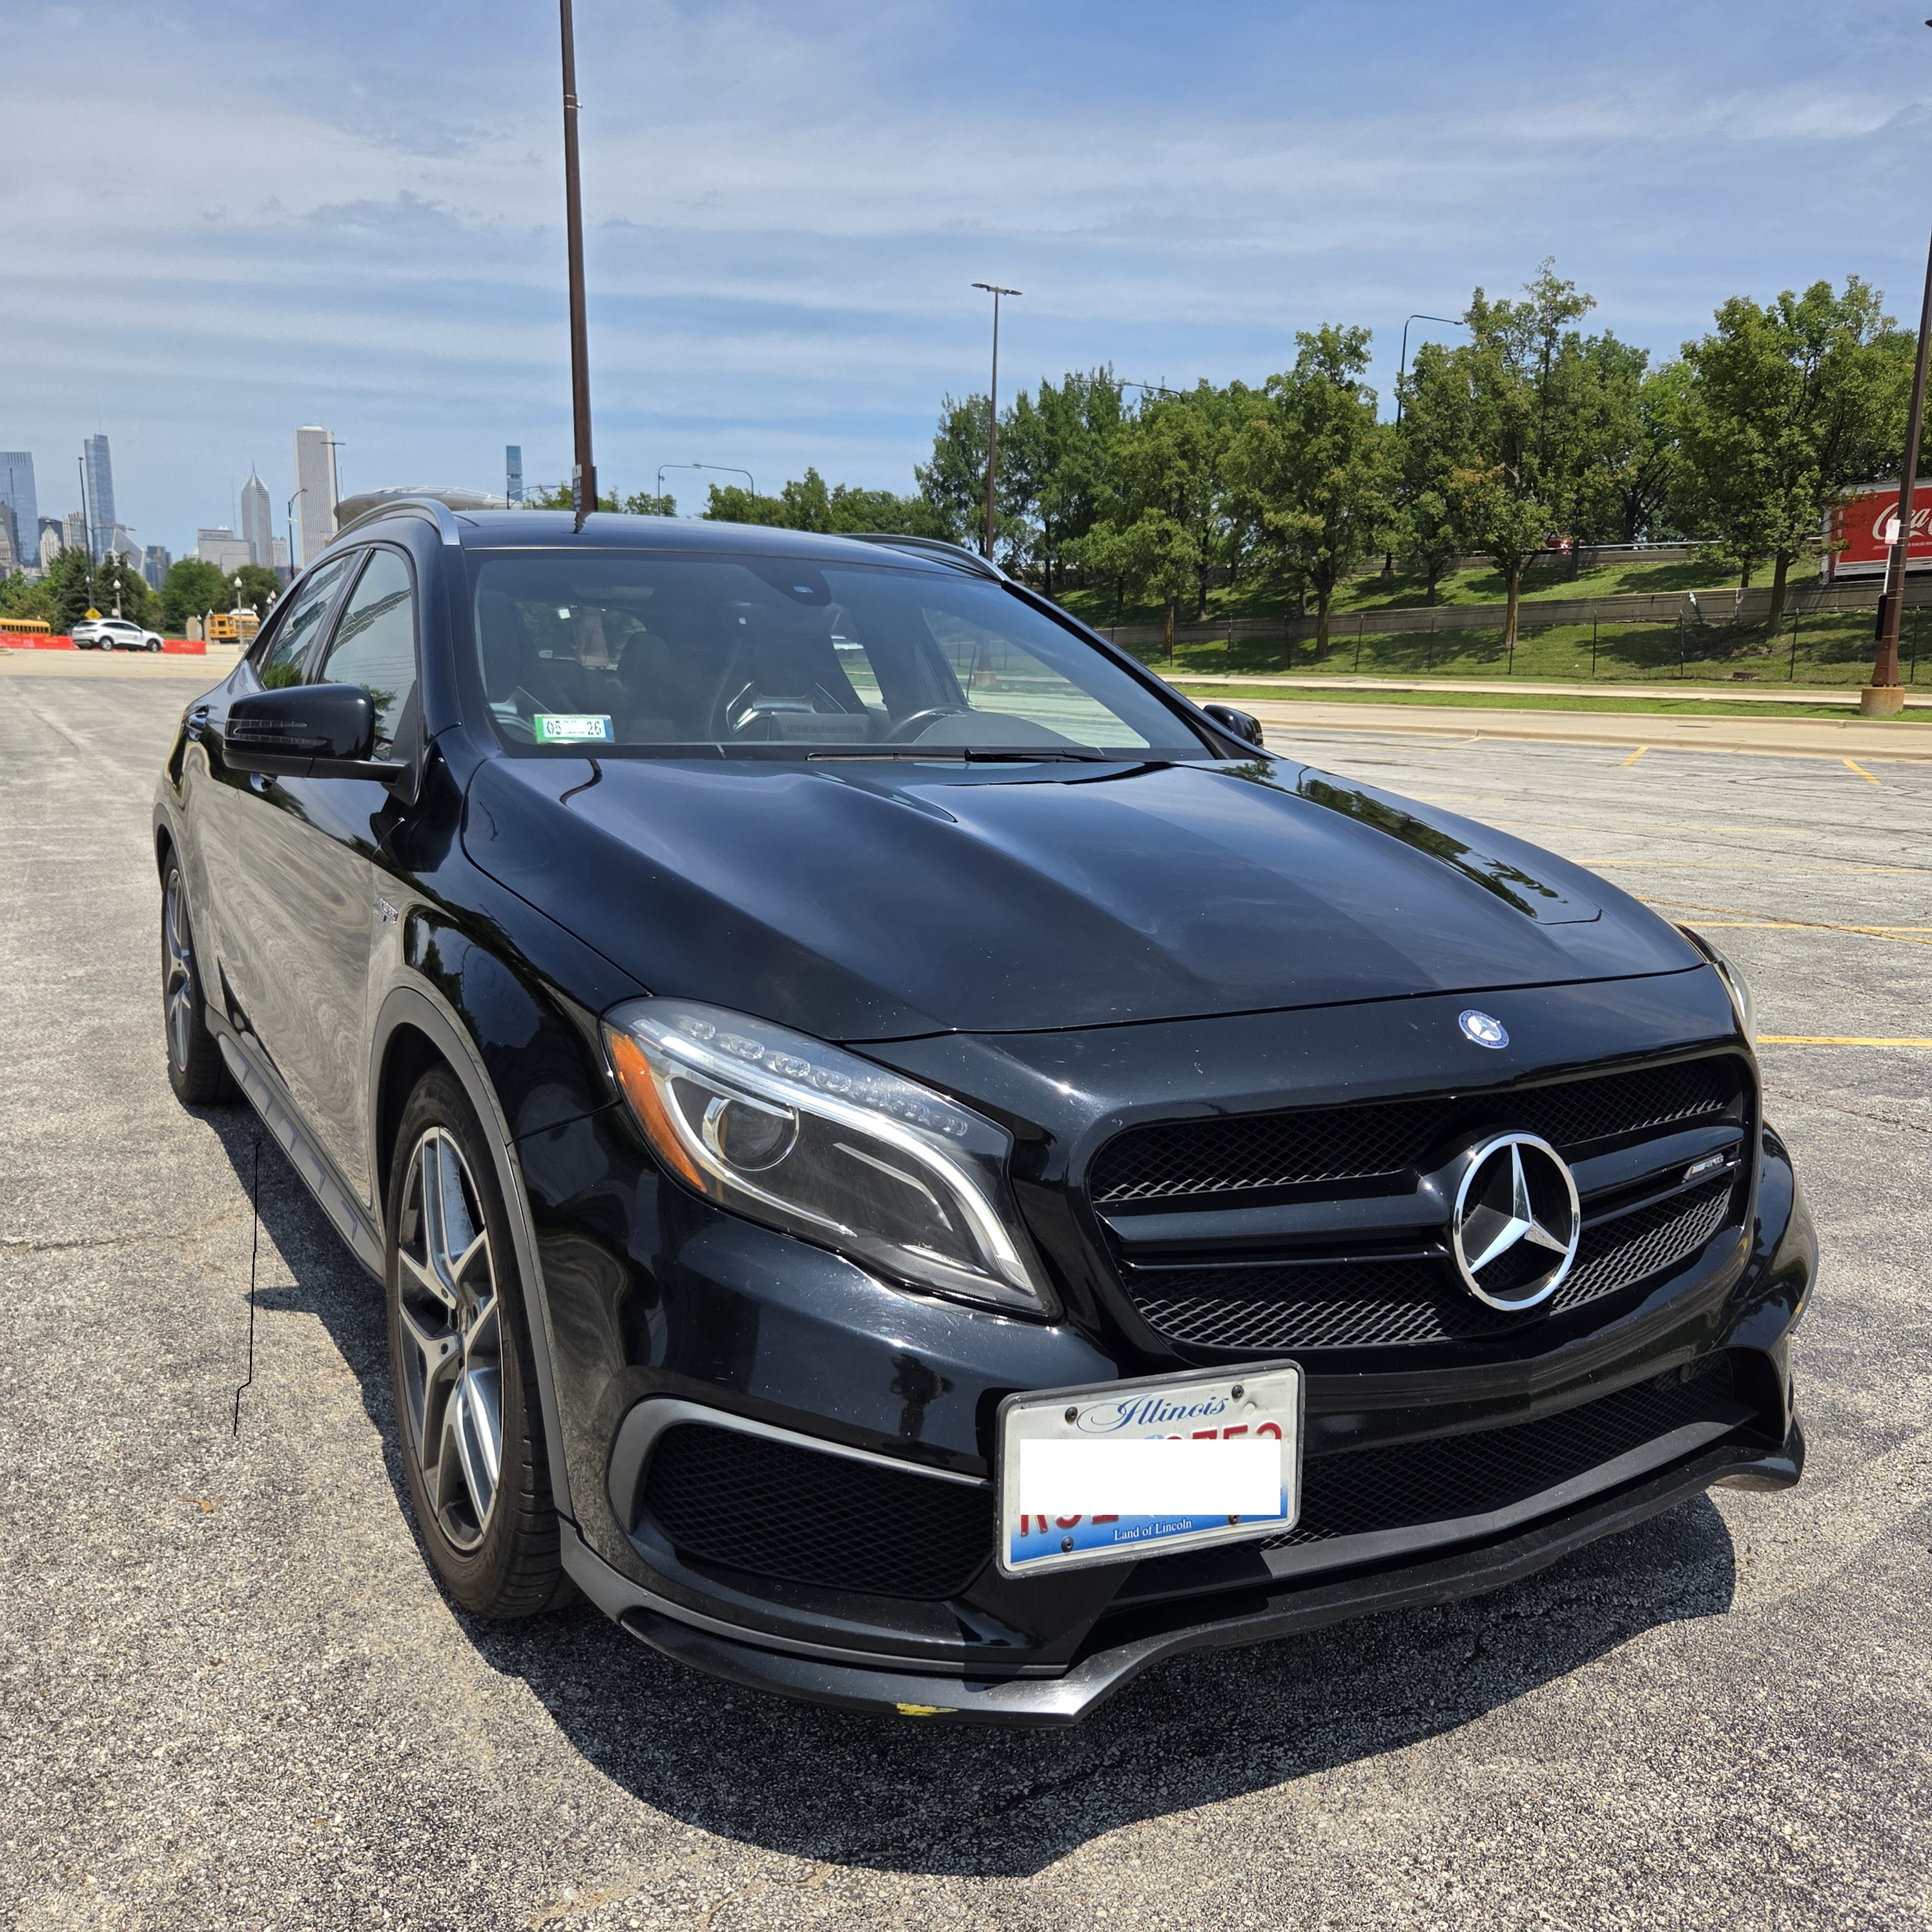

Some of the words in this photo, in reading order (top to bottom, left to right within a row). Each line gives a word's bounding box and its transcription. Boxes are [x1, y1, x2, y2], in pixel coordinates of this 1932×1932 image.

[547, 720, 562, 735] 05
[587, 721, 602, 735] 26
[1076, 1393, 1229, 1434] Illinois
[1114, 1526, 1140, 1541] Land
[1142, 1524, 1153, 1536] of
[1155, 1519, 1192, 1534] Lincoln
